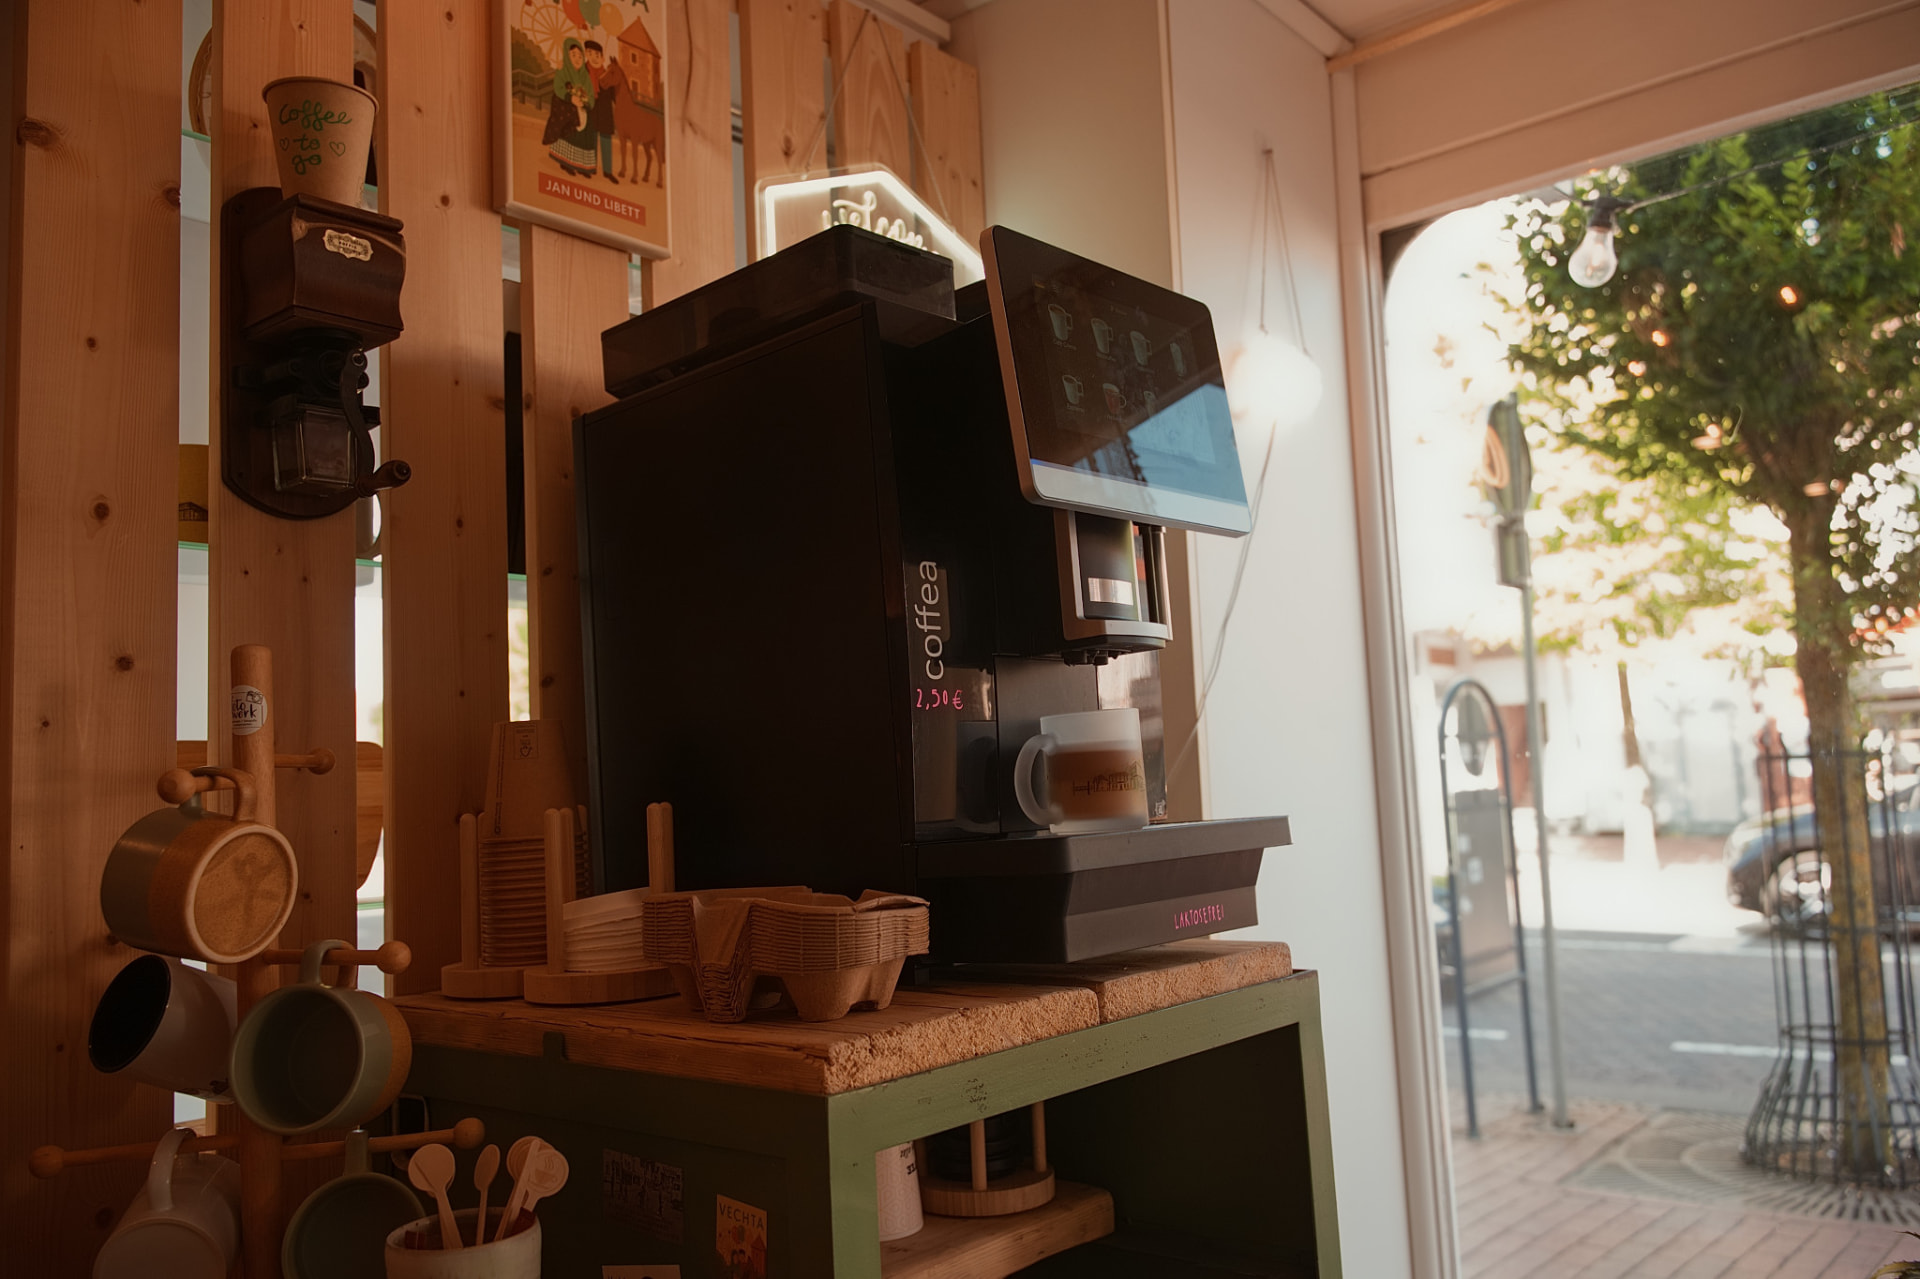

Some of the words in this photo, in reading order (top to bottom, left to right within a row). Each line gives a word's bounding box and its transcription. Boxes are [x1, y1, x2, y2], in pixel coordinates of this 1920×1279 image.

[293, 134, 320, 151] to
[292, 154, 322, 175] go
[545, 180, 571, 197] JAN
[573, 187, 601, 206] UND
[604, 198, 641, 219] LIBETT
[914, 560, 944, 680] coffea
[719, 1202, 764, 1231] VECHTA
